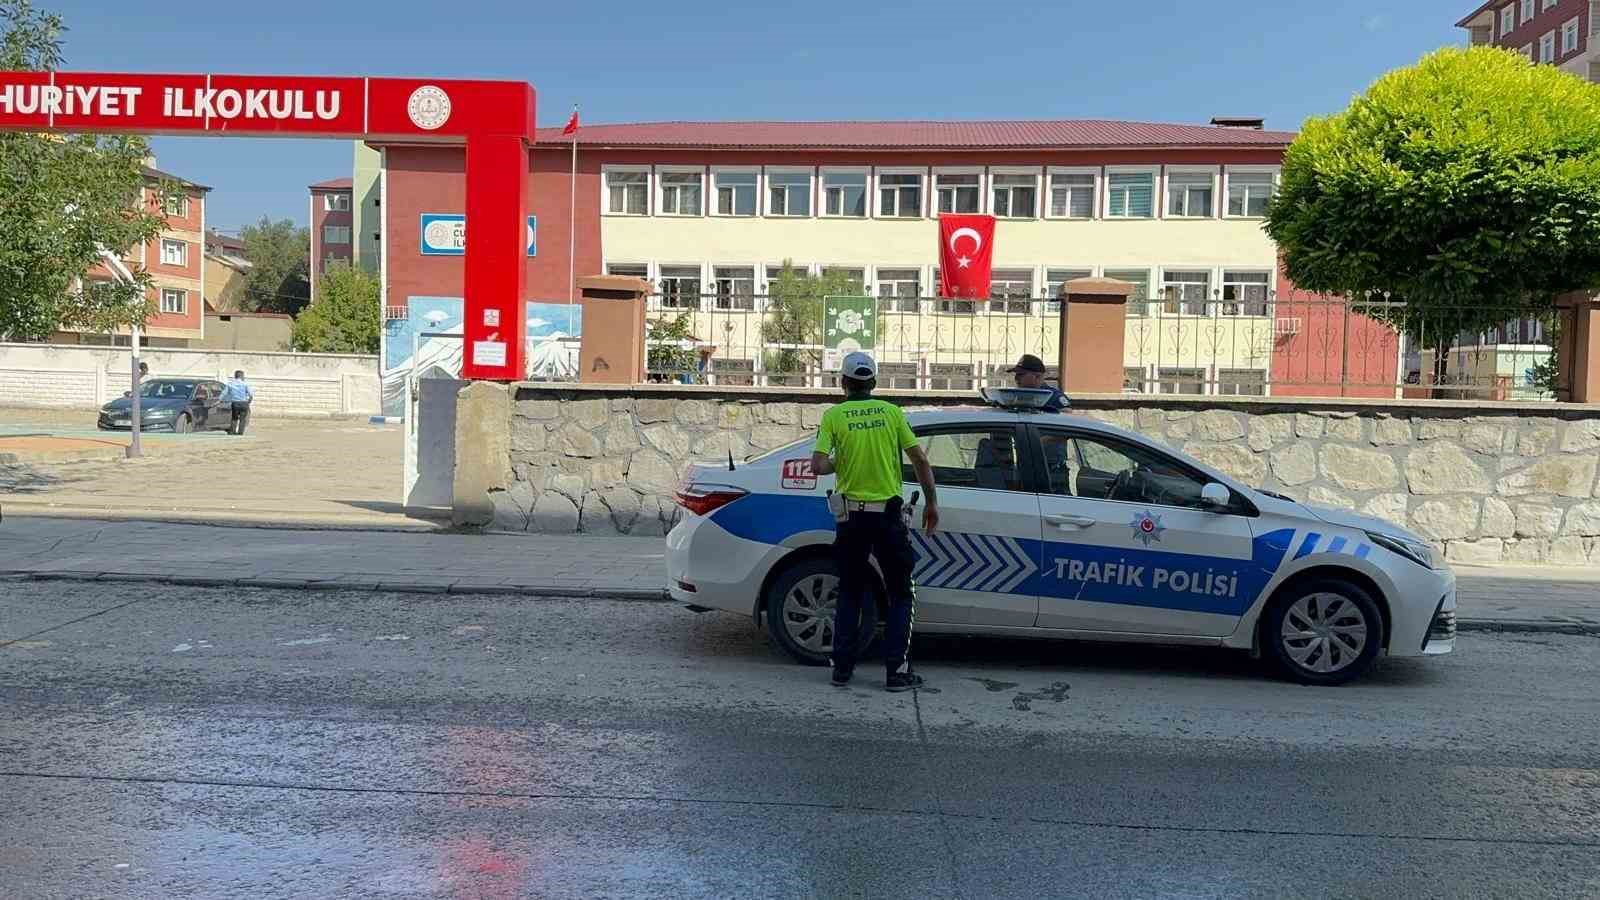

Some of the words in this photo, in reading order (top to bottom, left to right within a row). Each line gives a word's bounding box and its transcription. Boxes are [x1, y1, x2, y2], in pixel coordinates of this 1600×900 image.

[163, 87, 340, 119] İLKOKULU
[787, 461, 814, 476] 112
[1054, 558, 1145, 587] TRAFİK
[1152, 568, 1238, 597] POLİSİ
